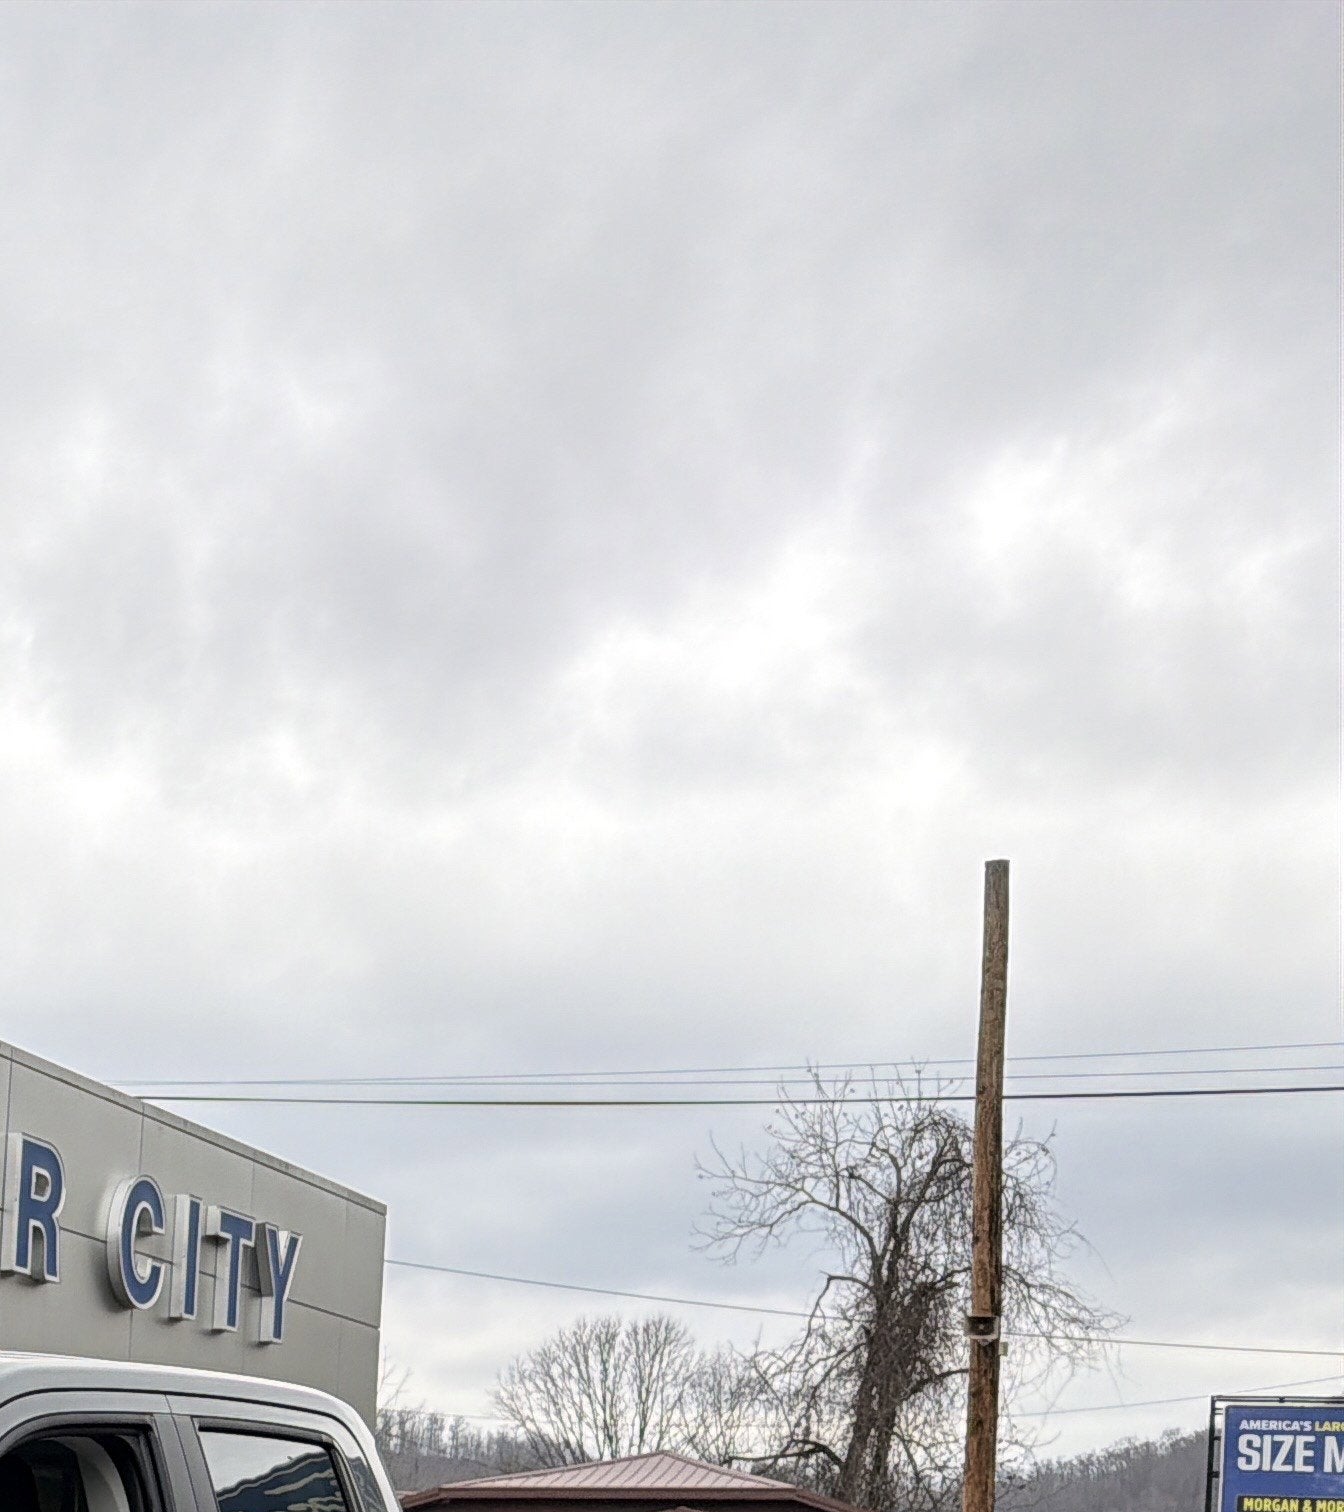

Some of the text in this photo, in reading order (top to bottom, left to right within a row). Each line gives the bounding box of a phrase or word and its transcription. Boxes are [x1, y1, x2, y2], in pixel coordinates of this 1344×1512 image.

[108, 1174, 303, 1344] CITY
[1239, 1419, 1313, 1432] AMERICA'S
[1237, 1433, 1316, 1473] SIZE
[1243, 1497, 1299, 1512] MORGAN
